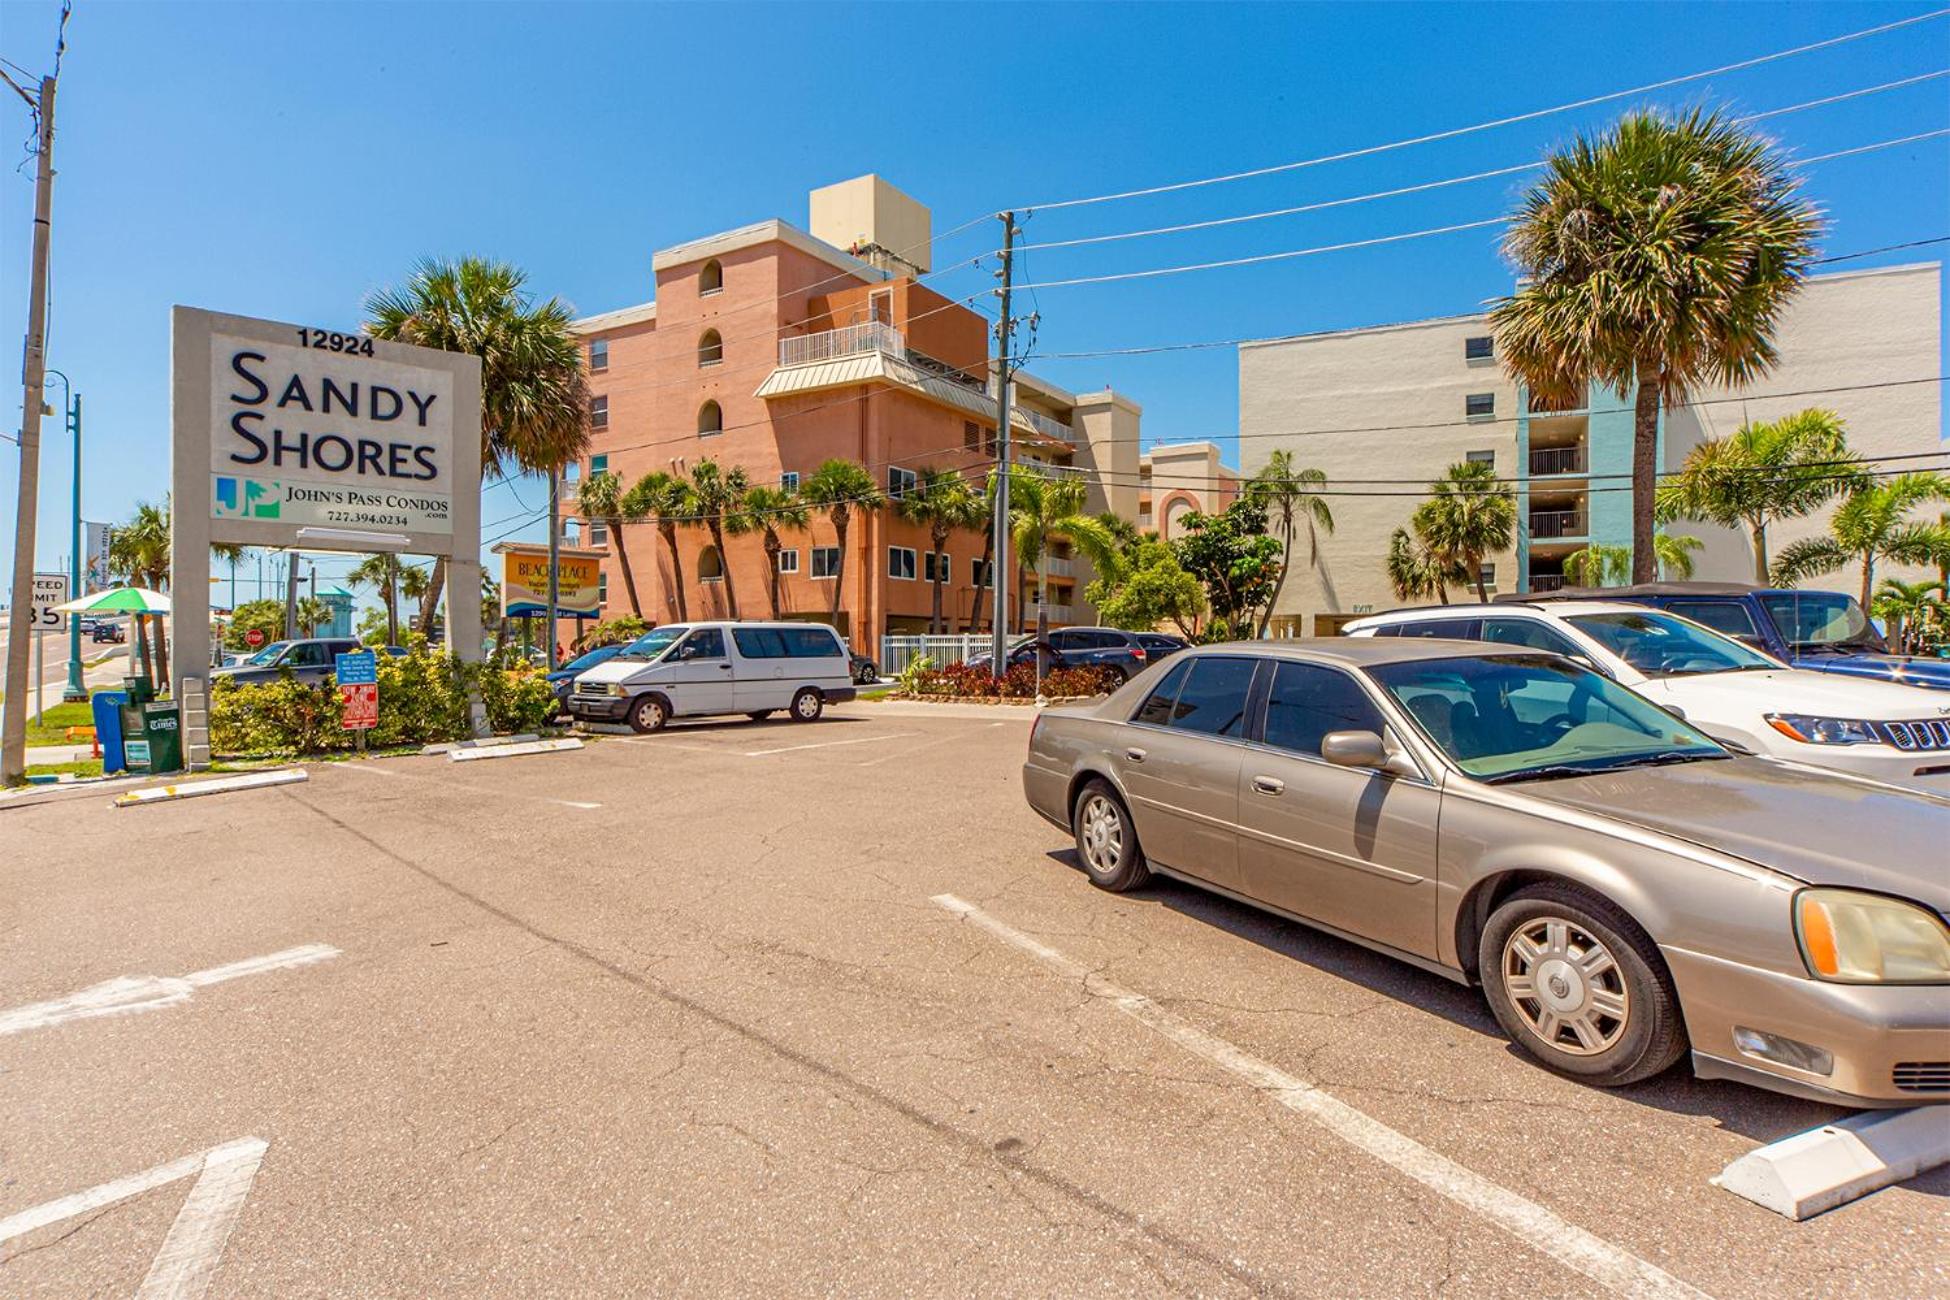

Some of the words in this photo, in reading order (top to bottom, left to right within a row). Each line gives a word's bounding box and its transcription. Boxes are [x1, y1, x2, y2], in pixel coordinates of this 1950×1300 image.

[297, 328, 375, 357] 12924
[230, 351, 437, 427] SANDY
[229, 410, 438, 481] SHORES
[286, 486, 343, 504] JOHN'S
[347, 491, 382, 507] PASS
[386, 495, 448, 513] CONDOS
[327, 510, 409, 527] 727.394.0234
[519, 562, 549, 577] BEAC
[32, 580, 63, 590] EED
[35, 593, 57, 602] MIT
[1353, 604, 1373, 613] EXIT
